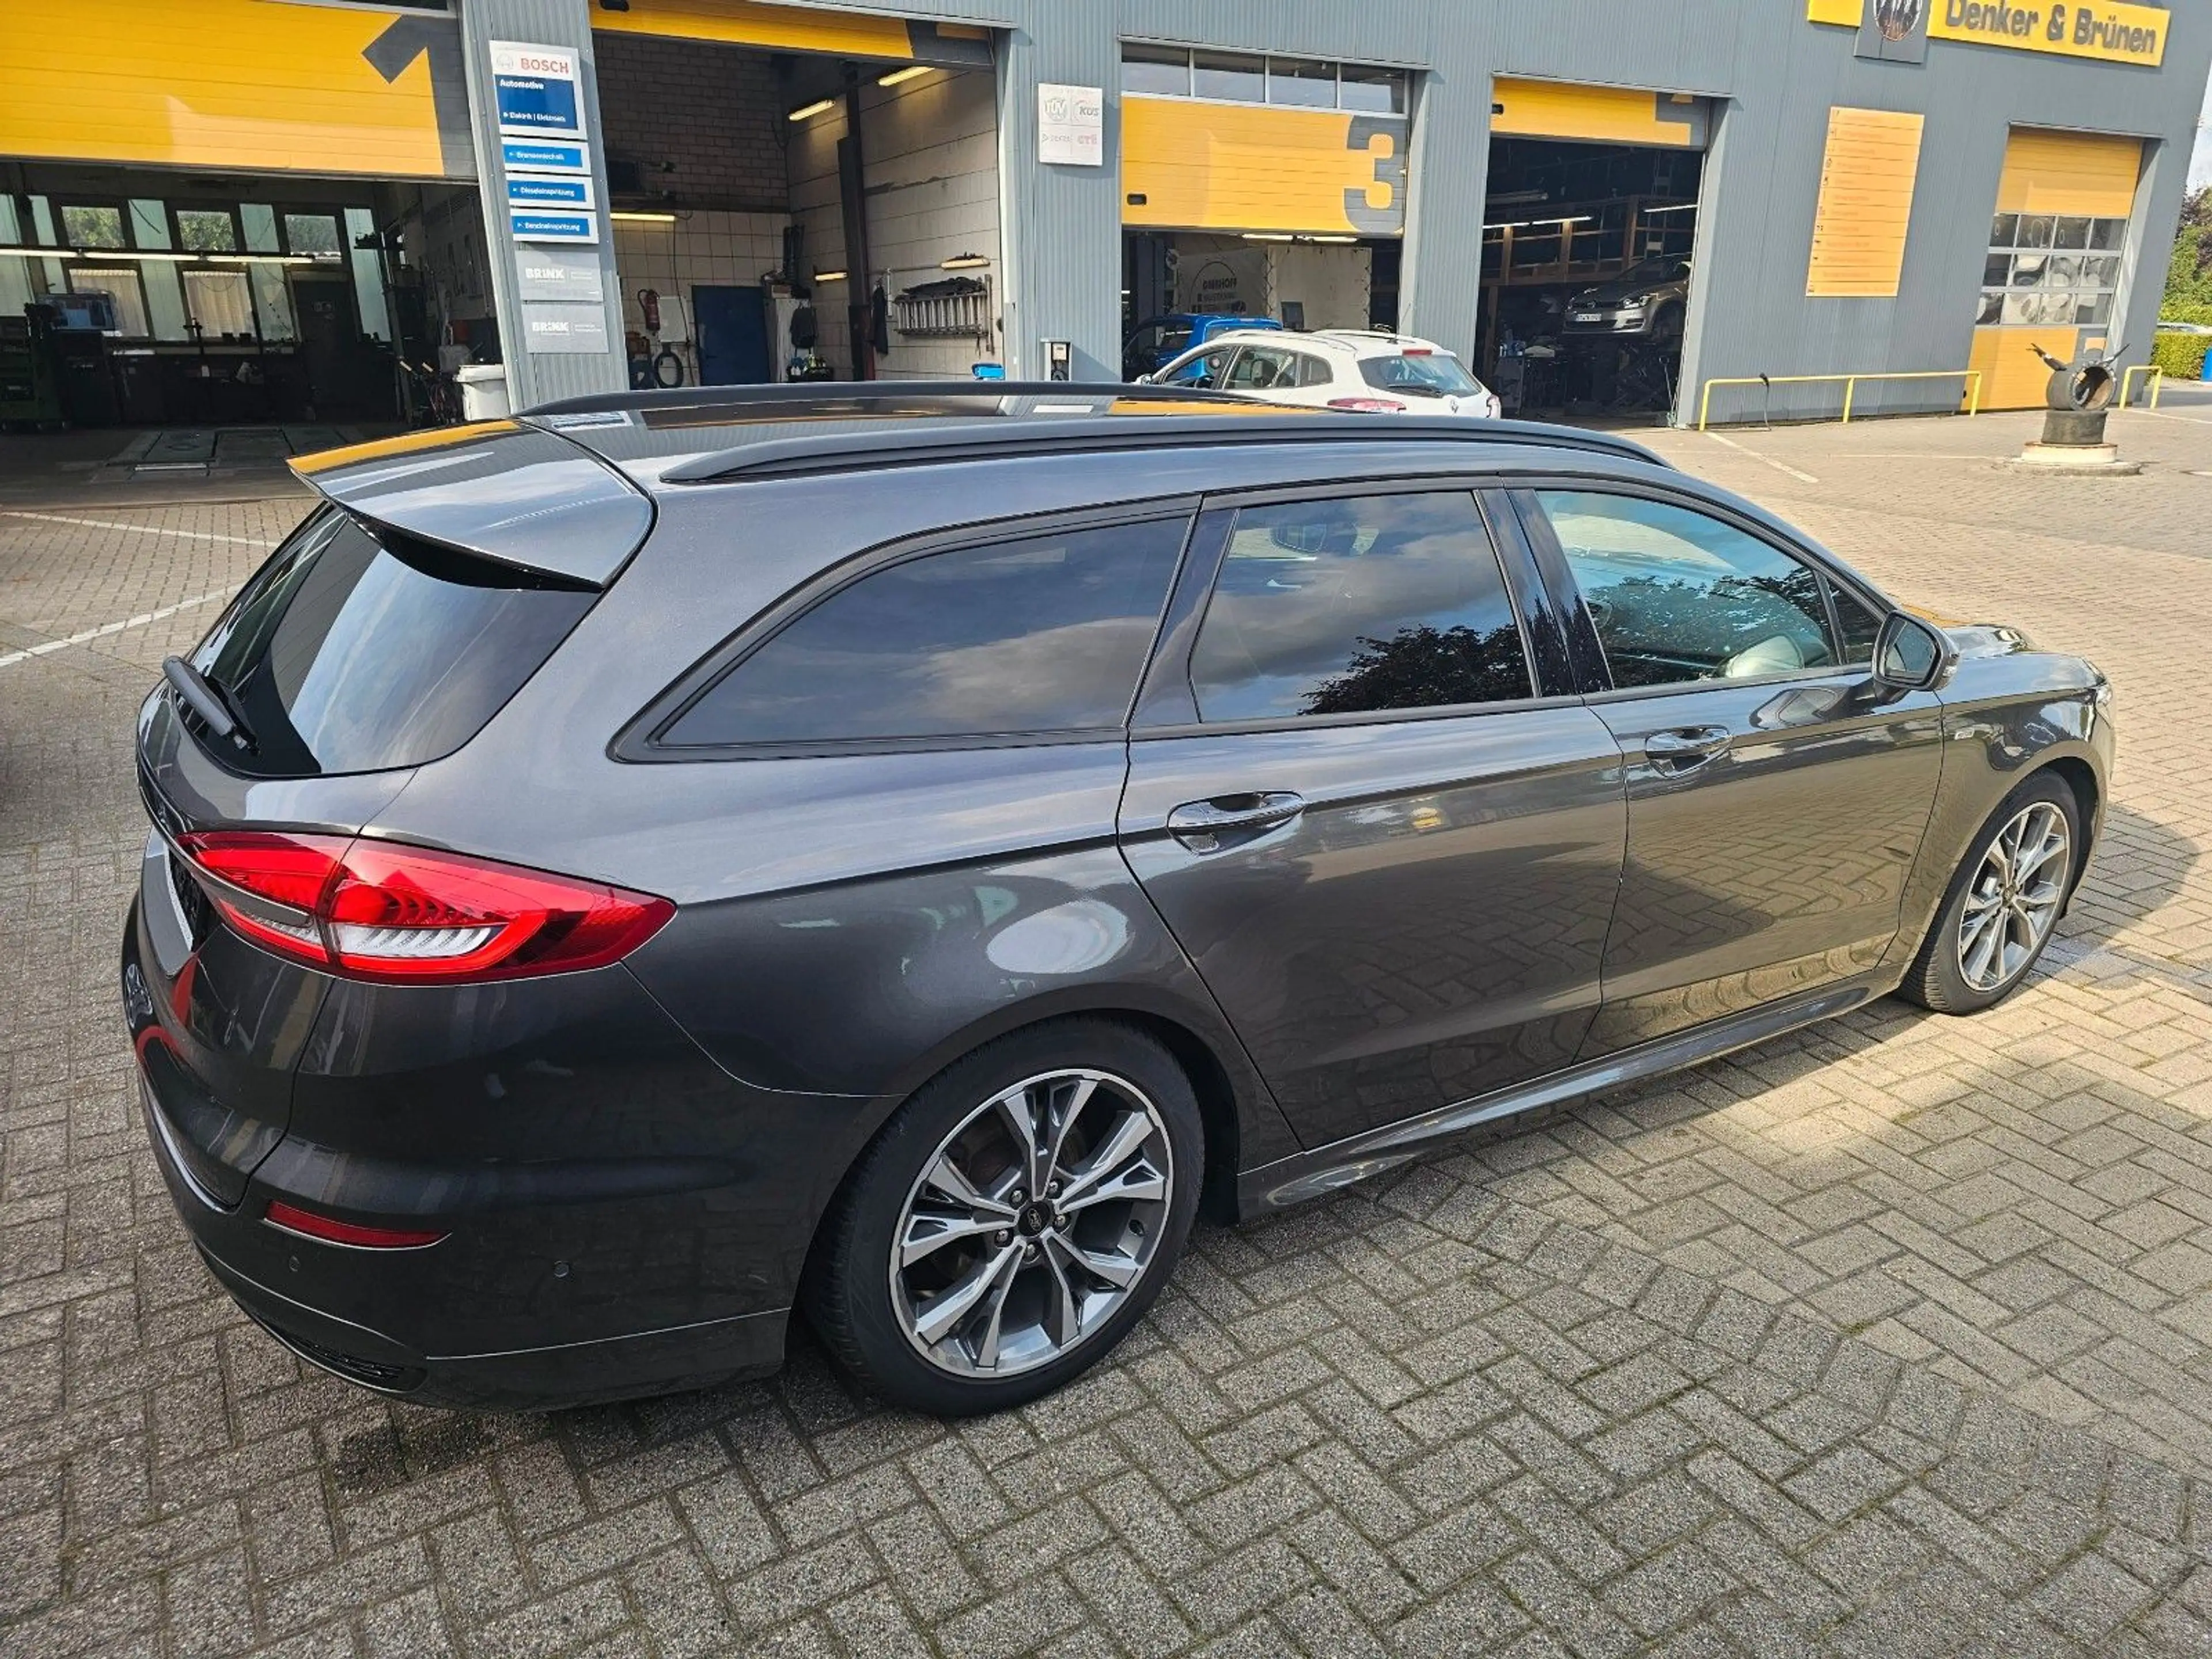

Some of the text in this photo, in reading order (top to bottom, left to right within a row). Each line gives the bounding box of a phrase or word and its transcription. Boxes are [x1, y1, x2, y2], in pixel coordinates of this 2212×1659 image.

[1945, 0, 2156, 54] Denker & Brünen
[521, 58, 569, 74] BOSCH
[500, 79, 544, 90] Automotive
[1344, 115, 1407, 232] 3
[525, 267, 565, 279] BRINK
